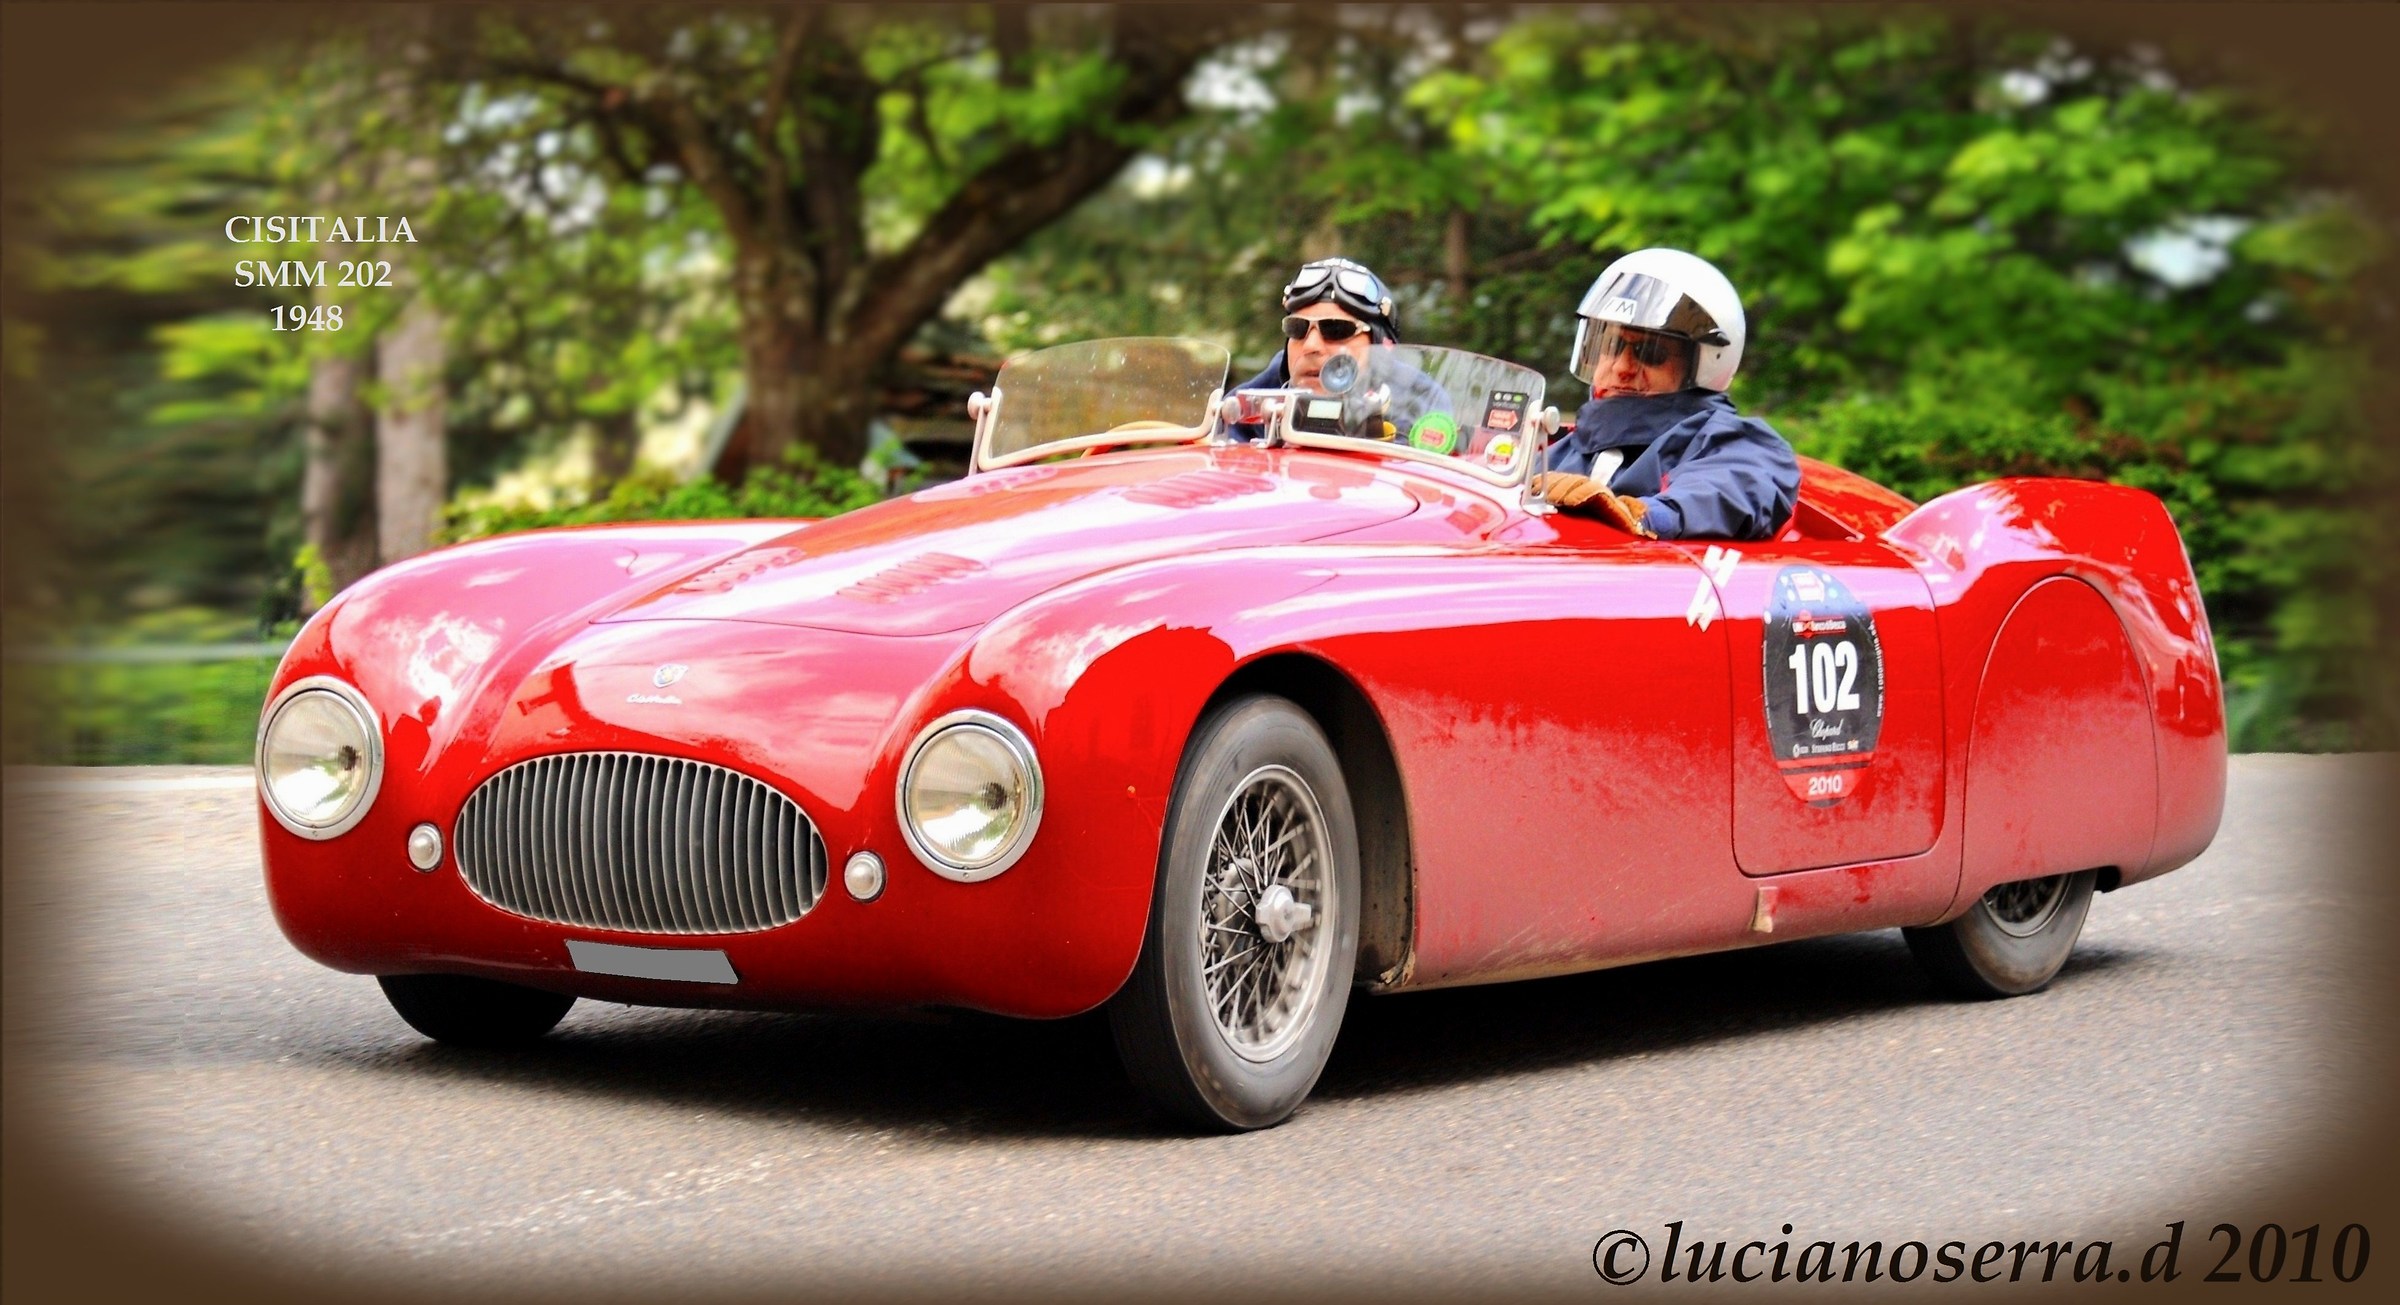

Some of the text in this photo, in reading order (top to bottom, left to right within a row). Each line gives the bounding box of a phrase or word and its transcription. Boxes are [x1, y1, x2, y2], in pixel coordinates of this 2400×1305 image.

[1788, 641, 1860, 714] 102
[1809, 718, 1844, 741] Chopard
[1808, 775, 1842, 795] 2010
